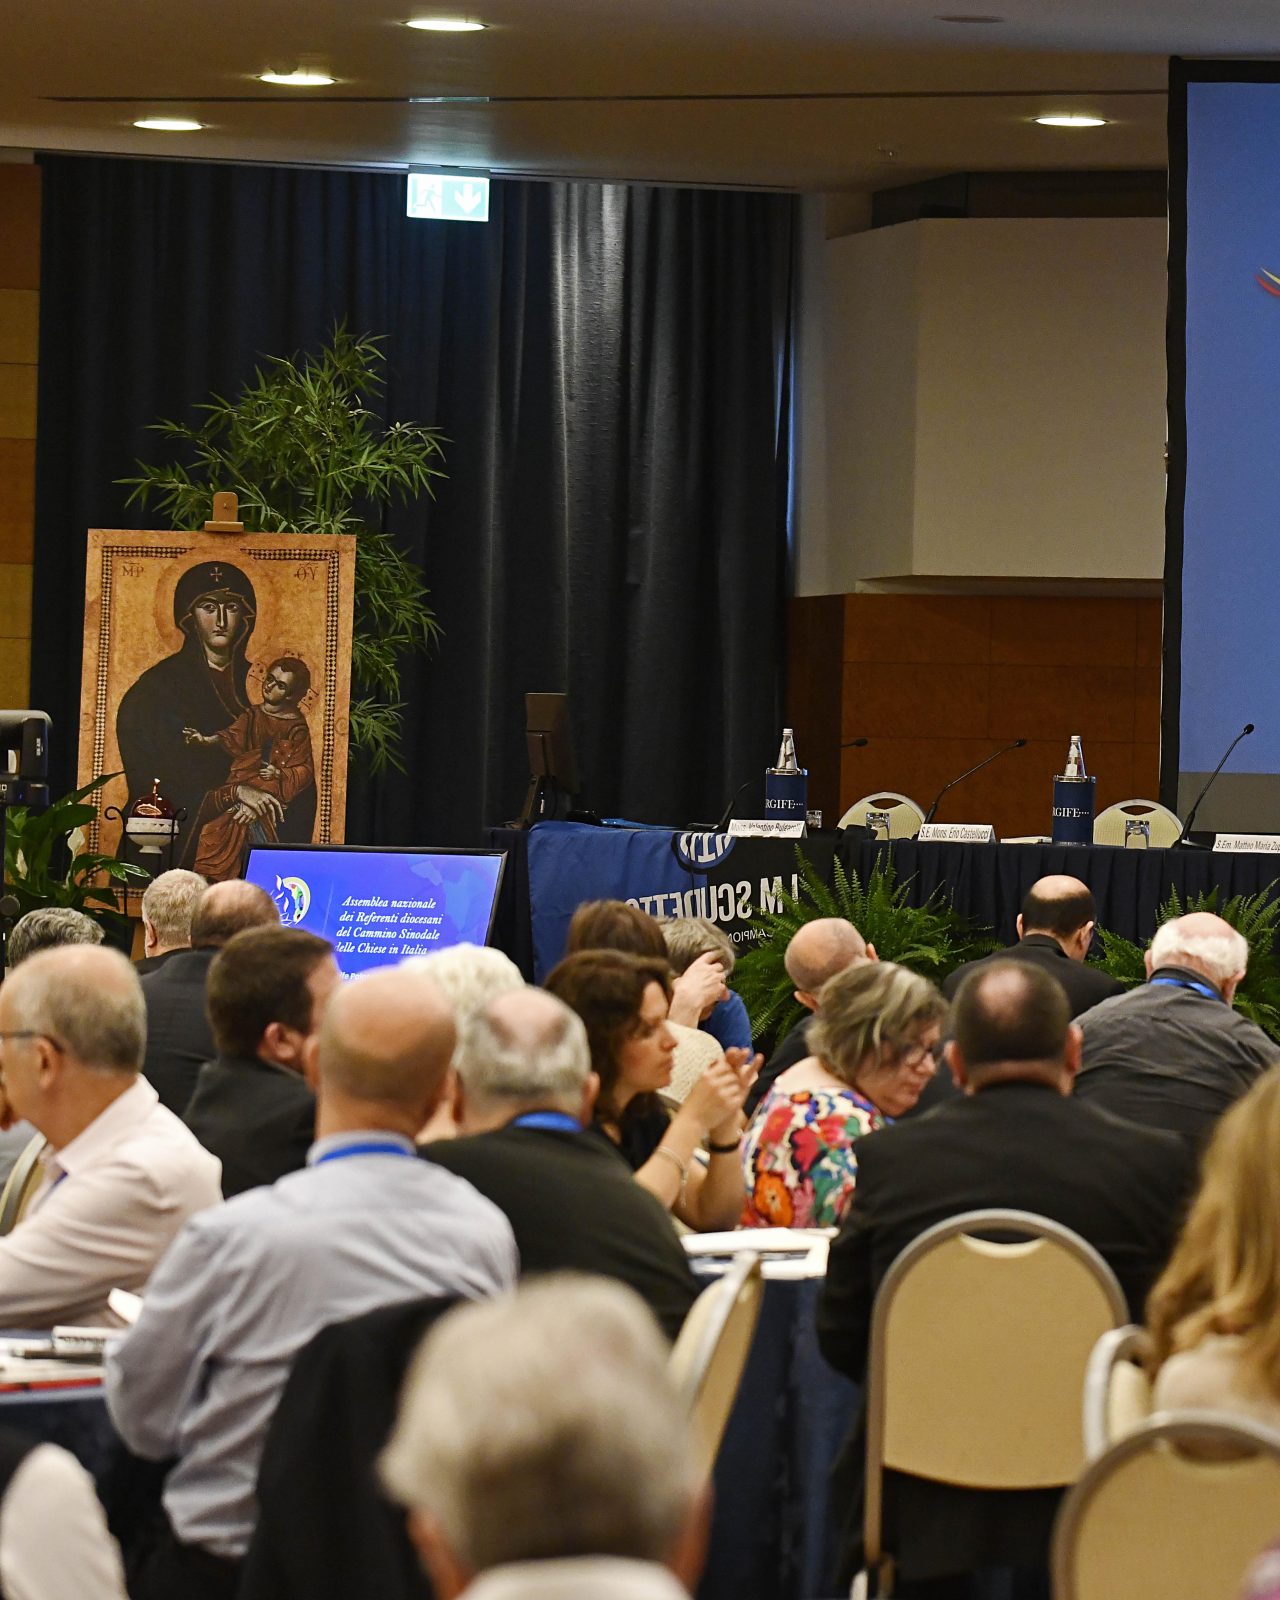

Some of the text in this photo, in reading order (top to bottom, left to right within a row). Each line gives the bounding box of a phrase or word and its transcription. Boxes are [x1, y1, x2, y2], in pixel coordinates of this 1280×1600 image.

[766, 799, 795, 809] RGIFE
[342, 896, 436, 909] Assemblea nazionale
[339, 911, 444, 925] dei Referenti diocesani
[336, 926, 440, 940] del Cammino Sinodale
[335, 942, 427, 955] delle Chiese in Italia
